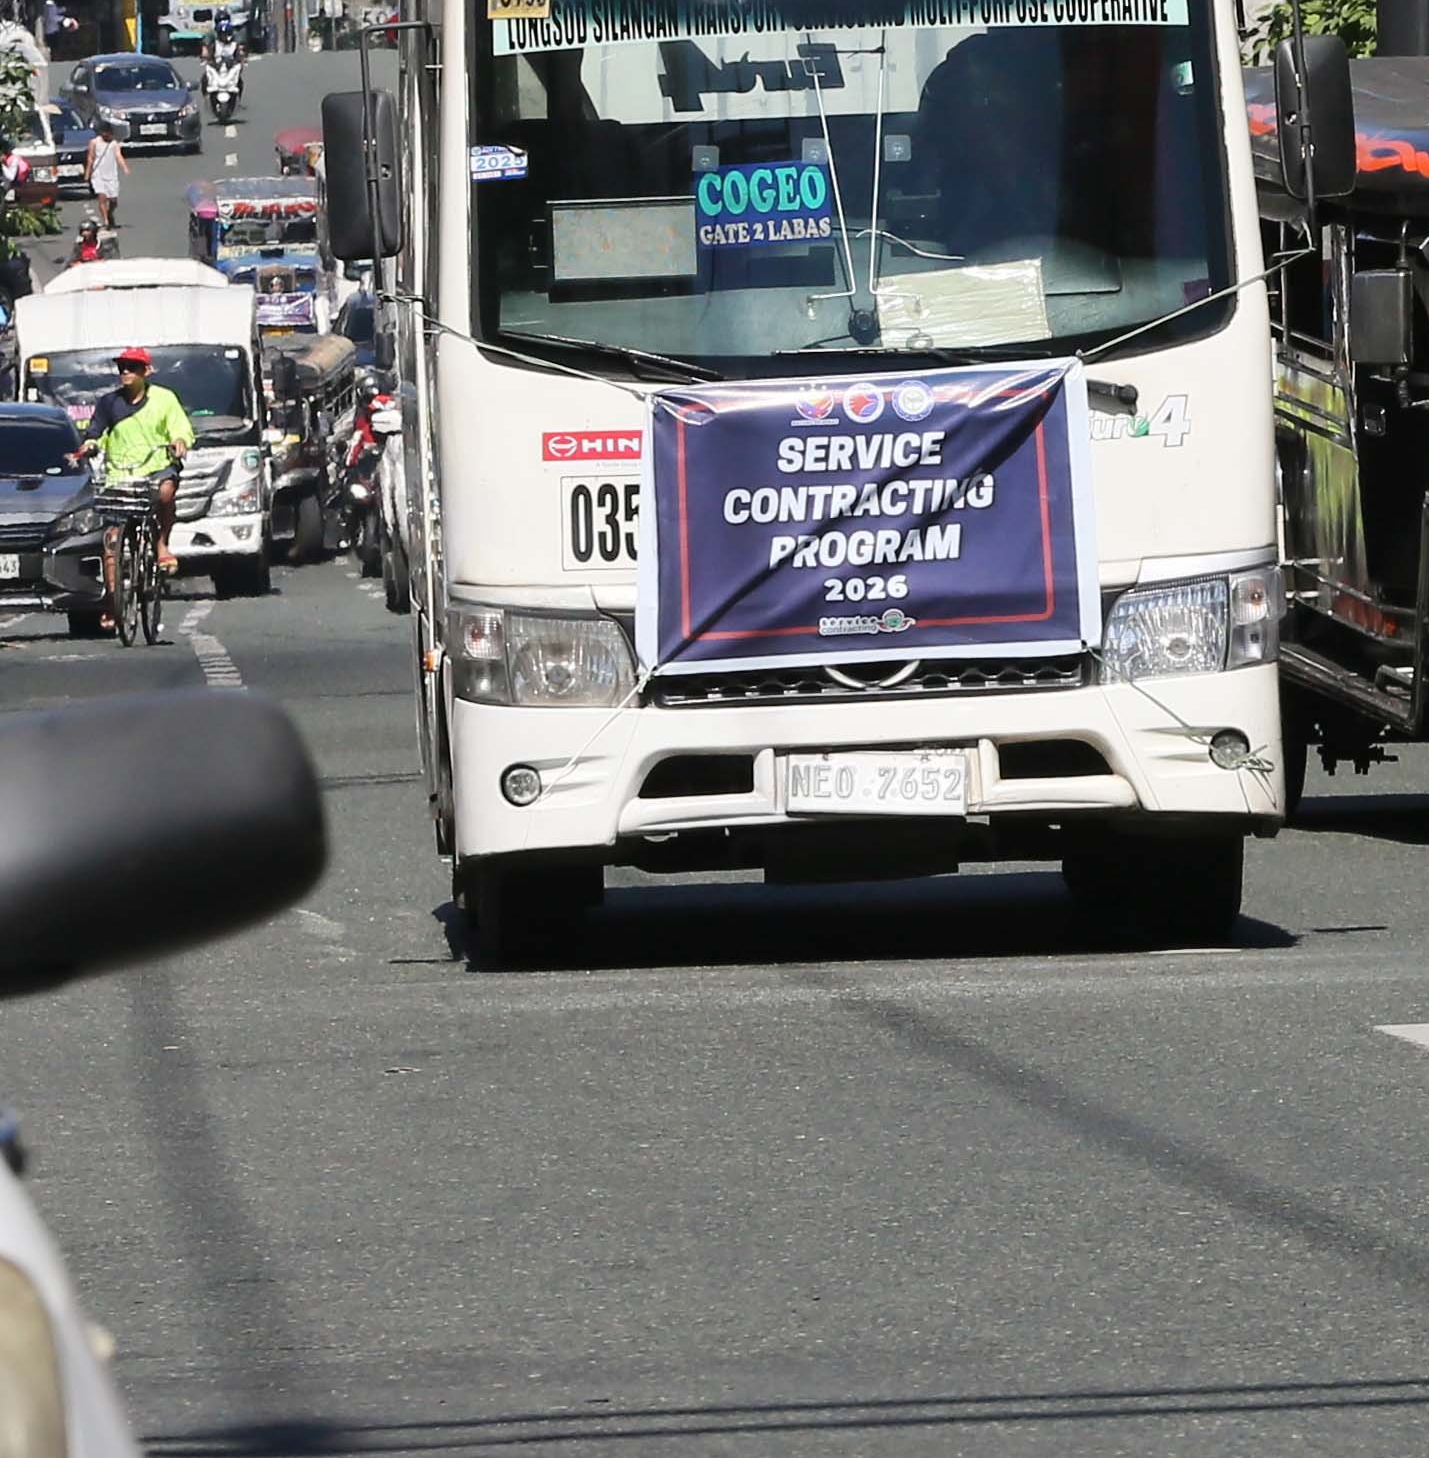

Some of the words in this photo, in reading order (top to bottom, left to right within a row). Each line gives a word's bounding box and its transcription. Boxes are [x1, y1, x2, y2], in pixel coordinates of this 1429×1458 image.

[476, 155, 524, 170] 2025
[698, 166, 826, 216] COGEO
[700, 222, 750, 245] GATE
[753, 223, 765, 241] 2
[767, 217, 831, 242] LABAS
[777, 431, 945, 473] SERVICE
[723, 472, 995, 524] CONTRACTING
[570, 482, 641, 563] 035
[769, 523, 961, 569] PROGRAM
[823, 574, 909, 601] 2026
[791, 764, 854, 799] NEO
[877, 766, 961, 801] 7652
